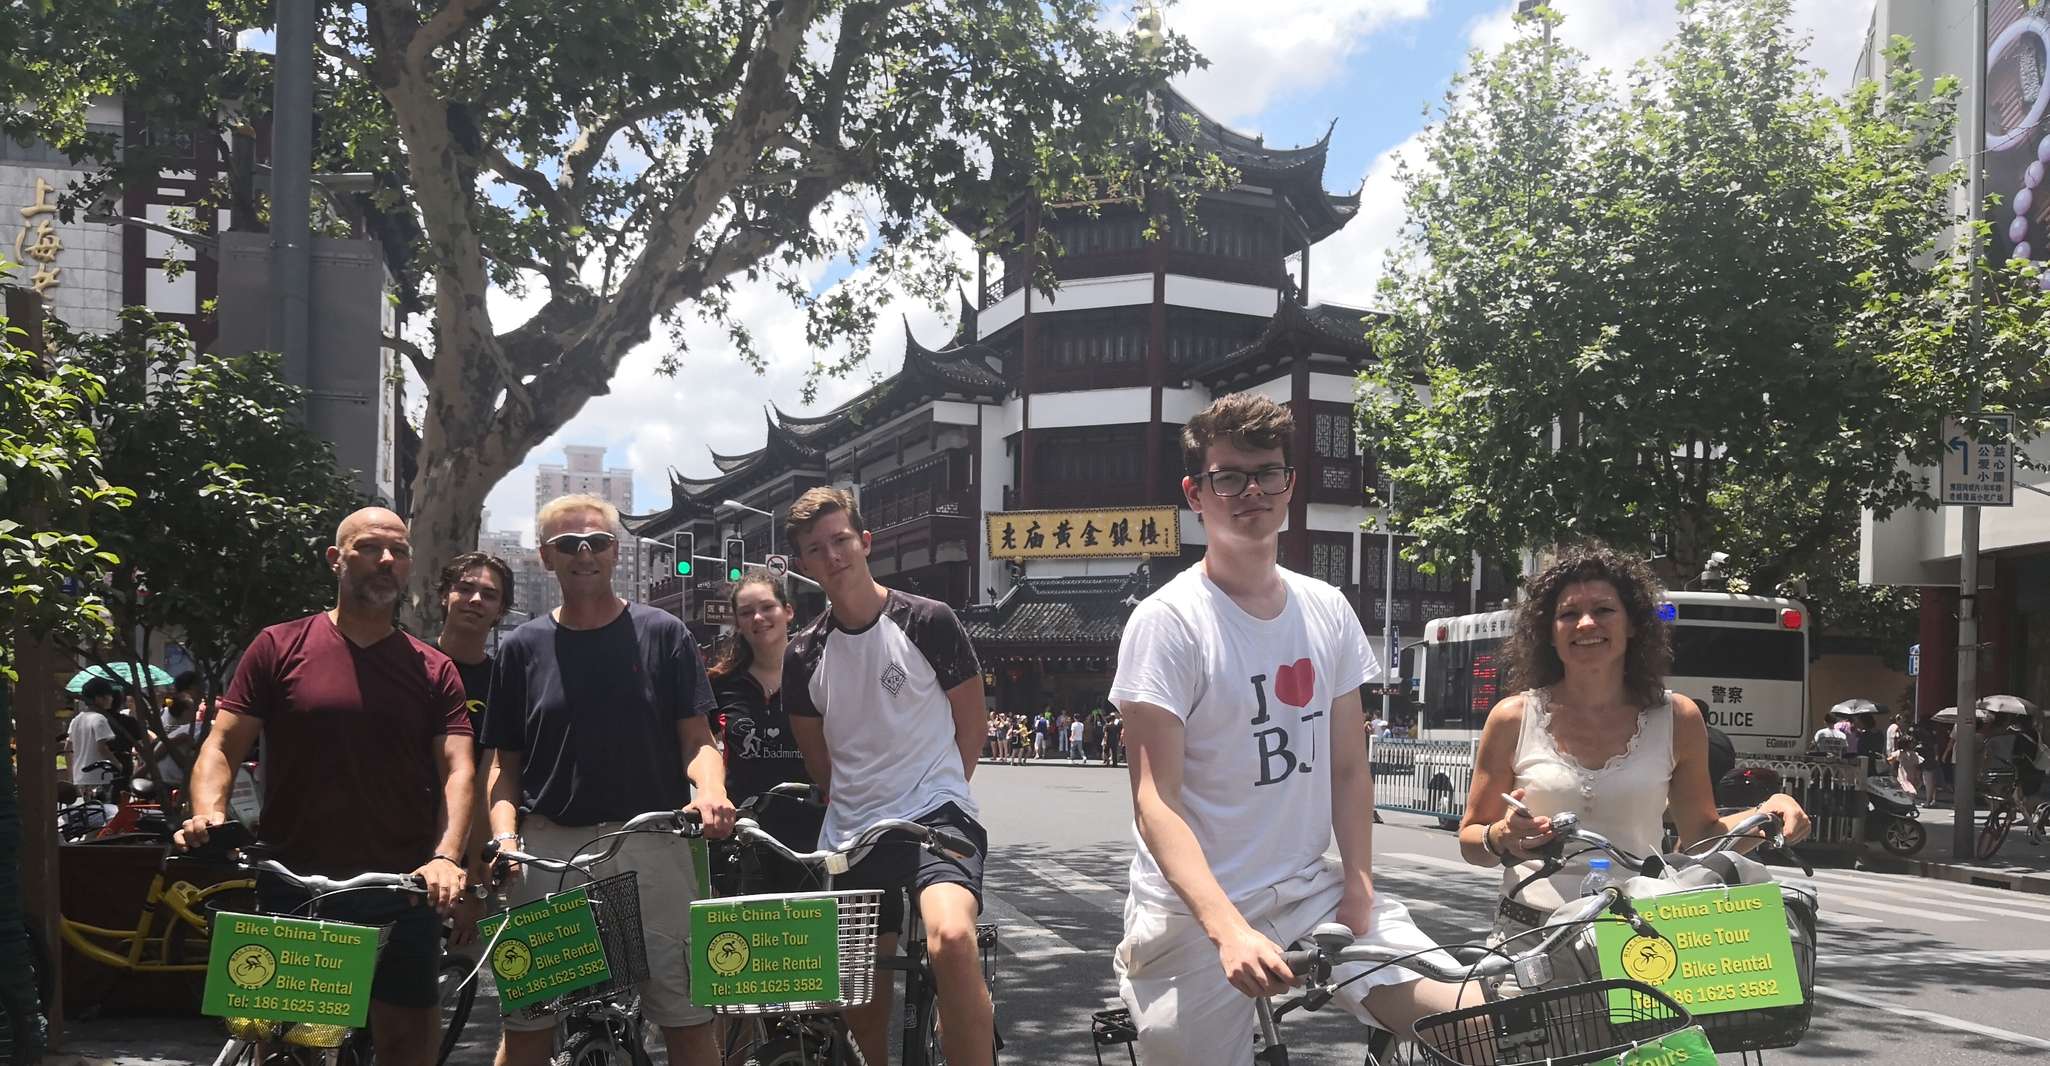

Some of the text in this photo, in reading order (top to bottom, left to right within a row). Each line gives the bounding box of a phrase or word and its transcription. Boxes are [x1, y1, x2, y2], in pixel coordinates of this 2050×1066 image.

[1250, 674, 1270, 725] I
[1711, 685, 1743, 704] 警察
[1707, 711, 1754, 727] OLICE
[1253, 711, 1323, 786] BJ
[514, 909, 550, 927] China
[552, 897, 588, 914] Tours
[707, 907, 822, 923] Bike China Tours
[1658, 901, 1709, 920] China
[1713, 898, 1763, 914] Tours
[234, 921, 361, 945] Bike China Tours
[528, 922, 581, 948] Bike Tour
[752, 931, 809, 947] Bike Tour
[1675, 931, 1712, 950] Bike
[1713, 927, 1751, 945] Tour
[280, 950, 310, 966] Bike
[314, 953, 344, 969] Tour
[535, 939, 600, 970] Bike Rental
[752, 956, 822, 972] Bike Rental
[1680, 953, 1773, 979] Bike Rental
[276, 975, 306, 992] Bike
[310, 978, 353, 995] Rental
[505, 985, 525, 1000] Tel:
[526, 978, 548, 993] 186
[548, 968, 576, 986] 1625
[577, 959, 607, 977] 3582
[711, 978, 823, 996] Tel: 186 1625 3582
[1666, 988, 1693, 1004] 86
[1698, 983, 1736, 1002] 1625
[1739, 979, 1779, 998] 3582
[227, 993, 351, 1016] Tel: 186 1625 3582
